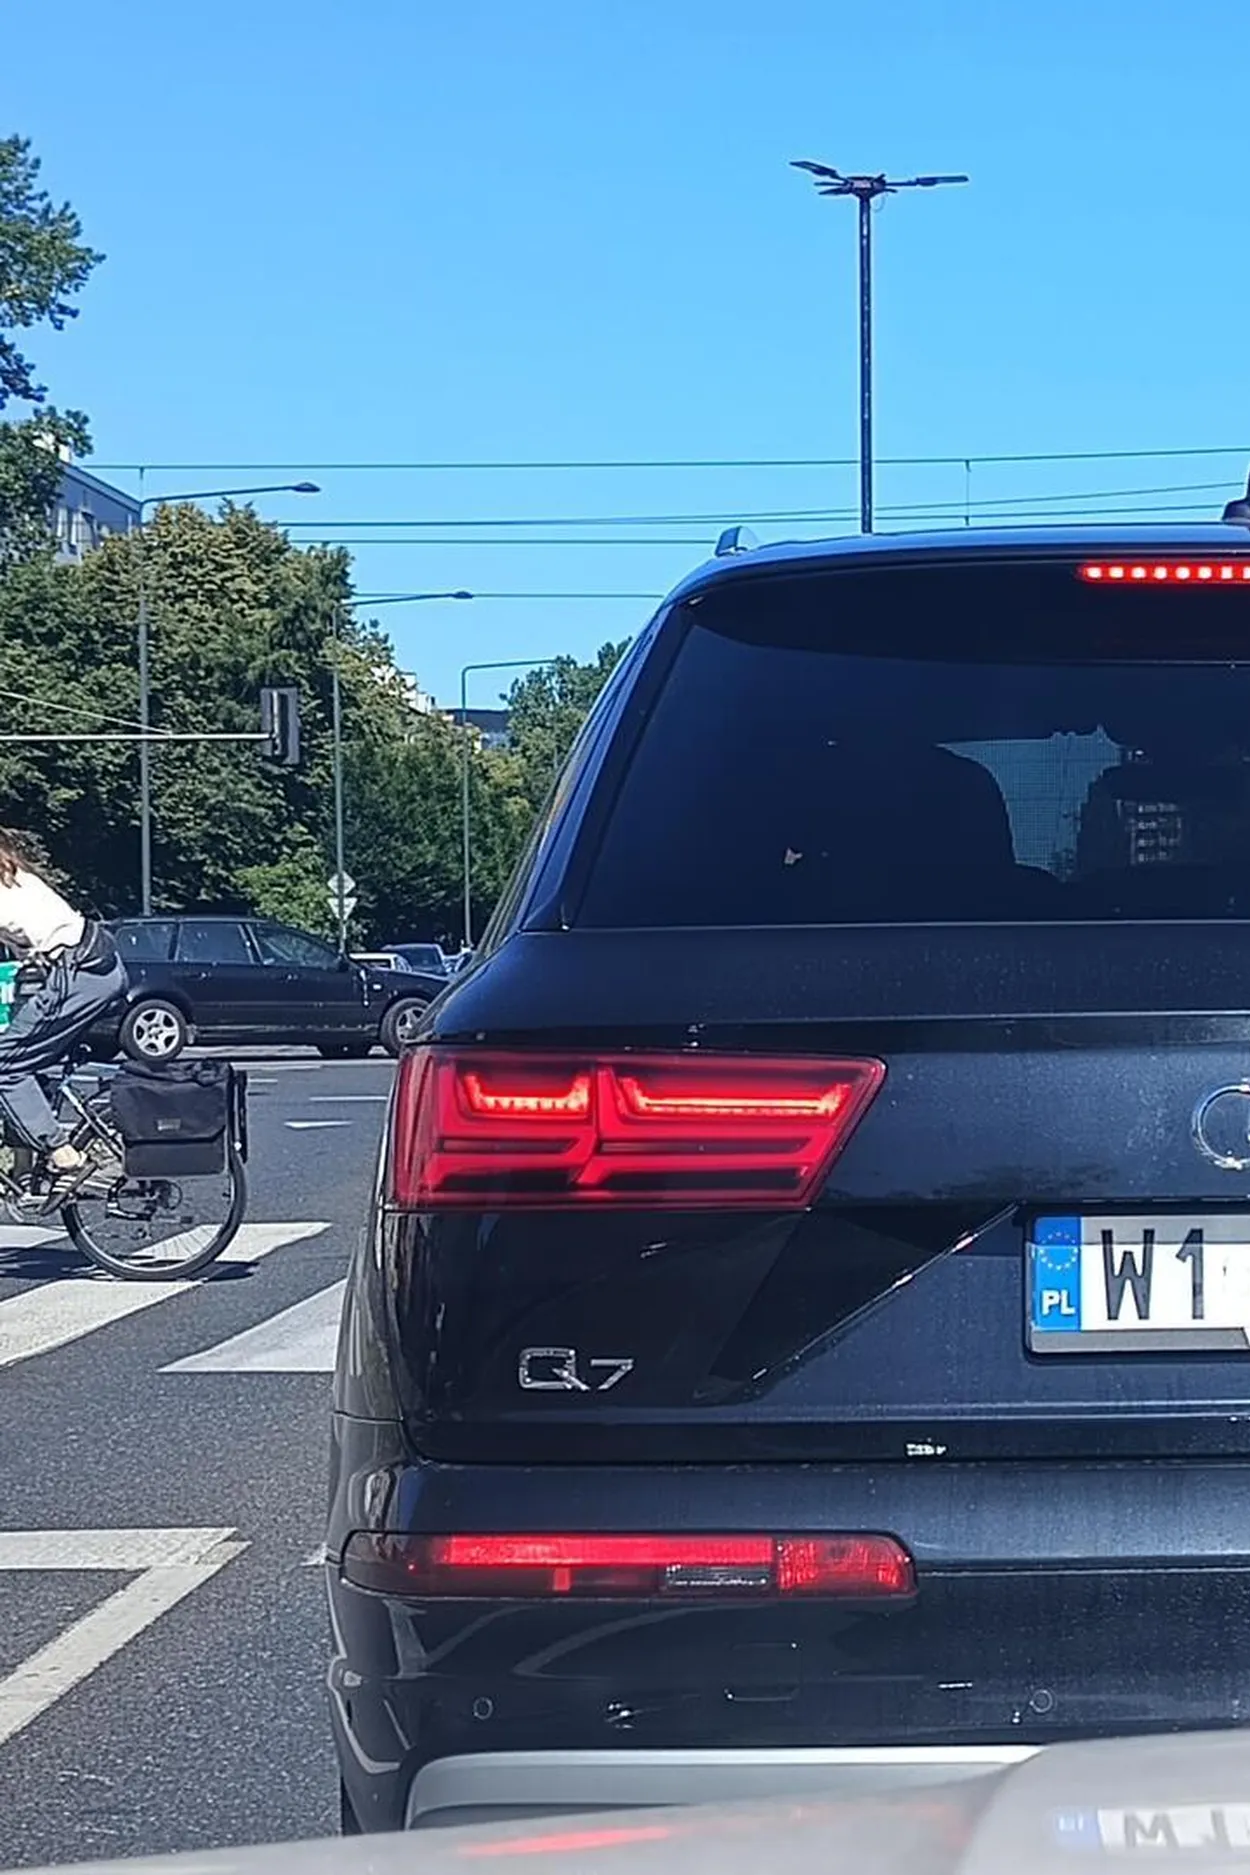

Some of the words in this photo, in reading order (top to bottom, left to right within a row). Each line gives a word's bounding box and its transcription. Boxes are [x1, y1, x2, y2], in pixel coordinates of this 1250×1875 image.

[1101, 1227, 1204, 1321] W1
[1041, 1290, 1076, 1315] PL
[520, 1347, 633, 1390] Q7
